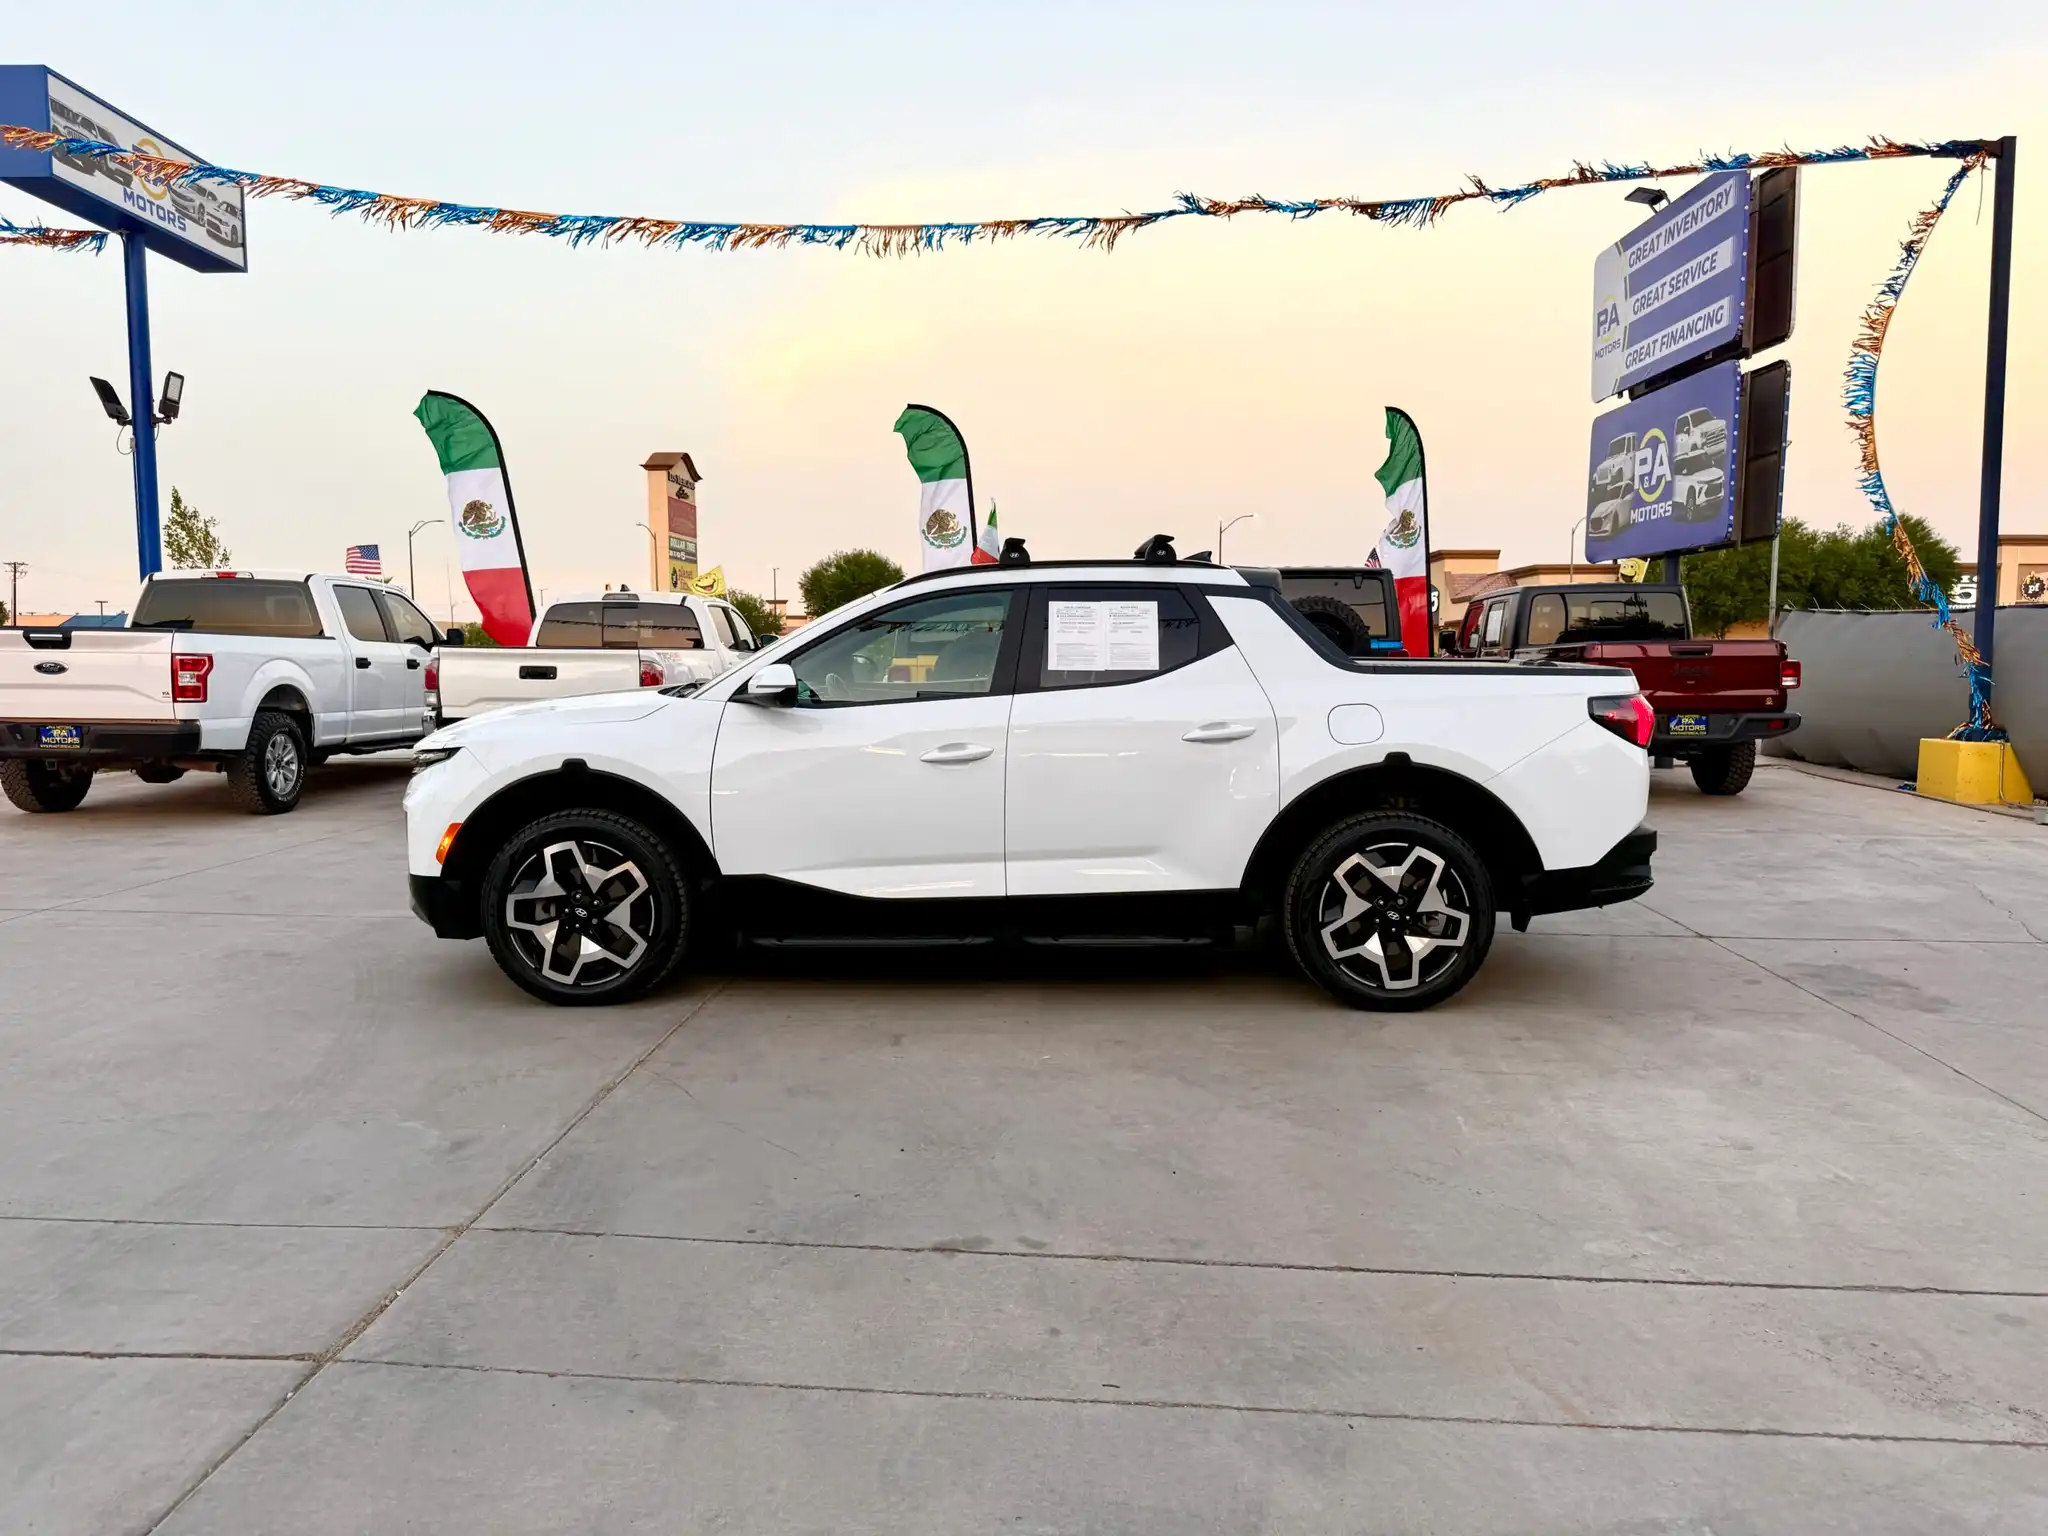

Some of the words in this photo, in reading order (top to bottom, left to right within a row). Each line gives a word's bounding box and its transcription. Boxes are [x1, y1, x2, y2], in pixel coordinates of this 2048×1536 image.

[123, 187, 187, 232] MOTORS
[1628, 232, 1663, 268] GREAT
[1663, 184, 1733, 245] INVENTORY
[1632, 280, 1667, 316] GREAT
[1668, 251, 1718, 295] SERVICE
[1594, 338, 1622, 360] MOTORS
[1625, 336, 1659, 370] GREAT
[1660, 304, 1724, 351] FINANCING
[1630, 500, 1672, 525] MOTORS
[42, 736, 80, 744] MOTORS
